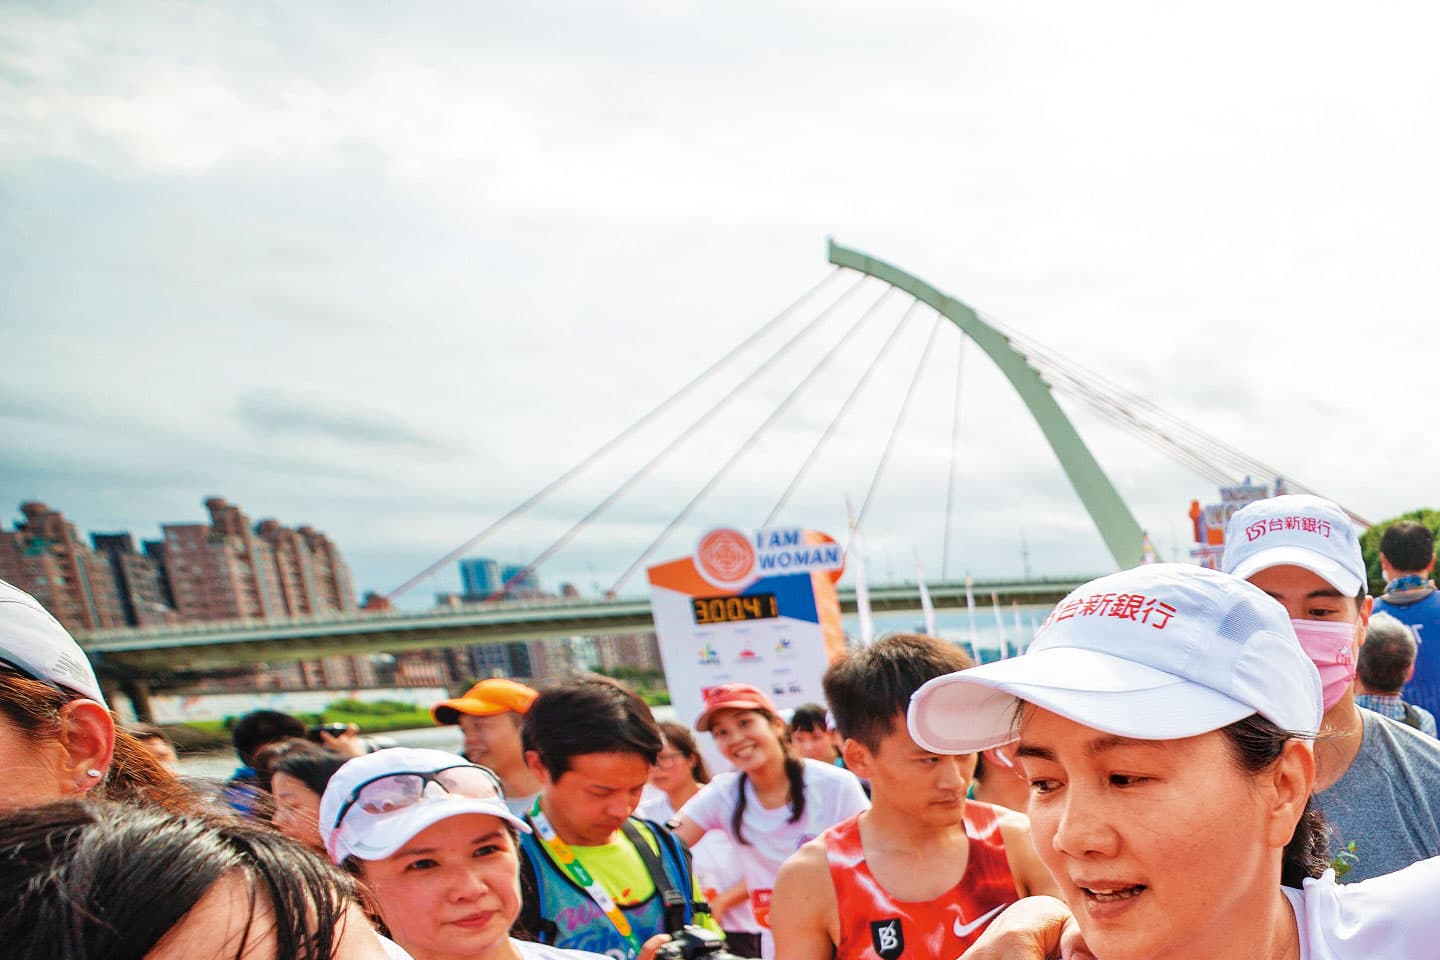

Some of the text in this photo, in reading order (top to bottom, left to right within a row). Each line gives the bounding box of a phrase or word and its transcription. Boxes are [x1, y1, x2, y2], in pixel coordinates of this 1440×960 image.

[1268, 516, 1331, 538] 台新銀行
[769, 529, 799, 547] AM
[759, 548, 838, 569] WOMAN
[1055, 593, 1177, 630] 台新銀行
